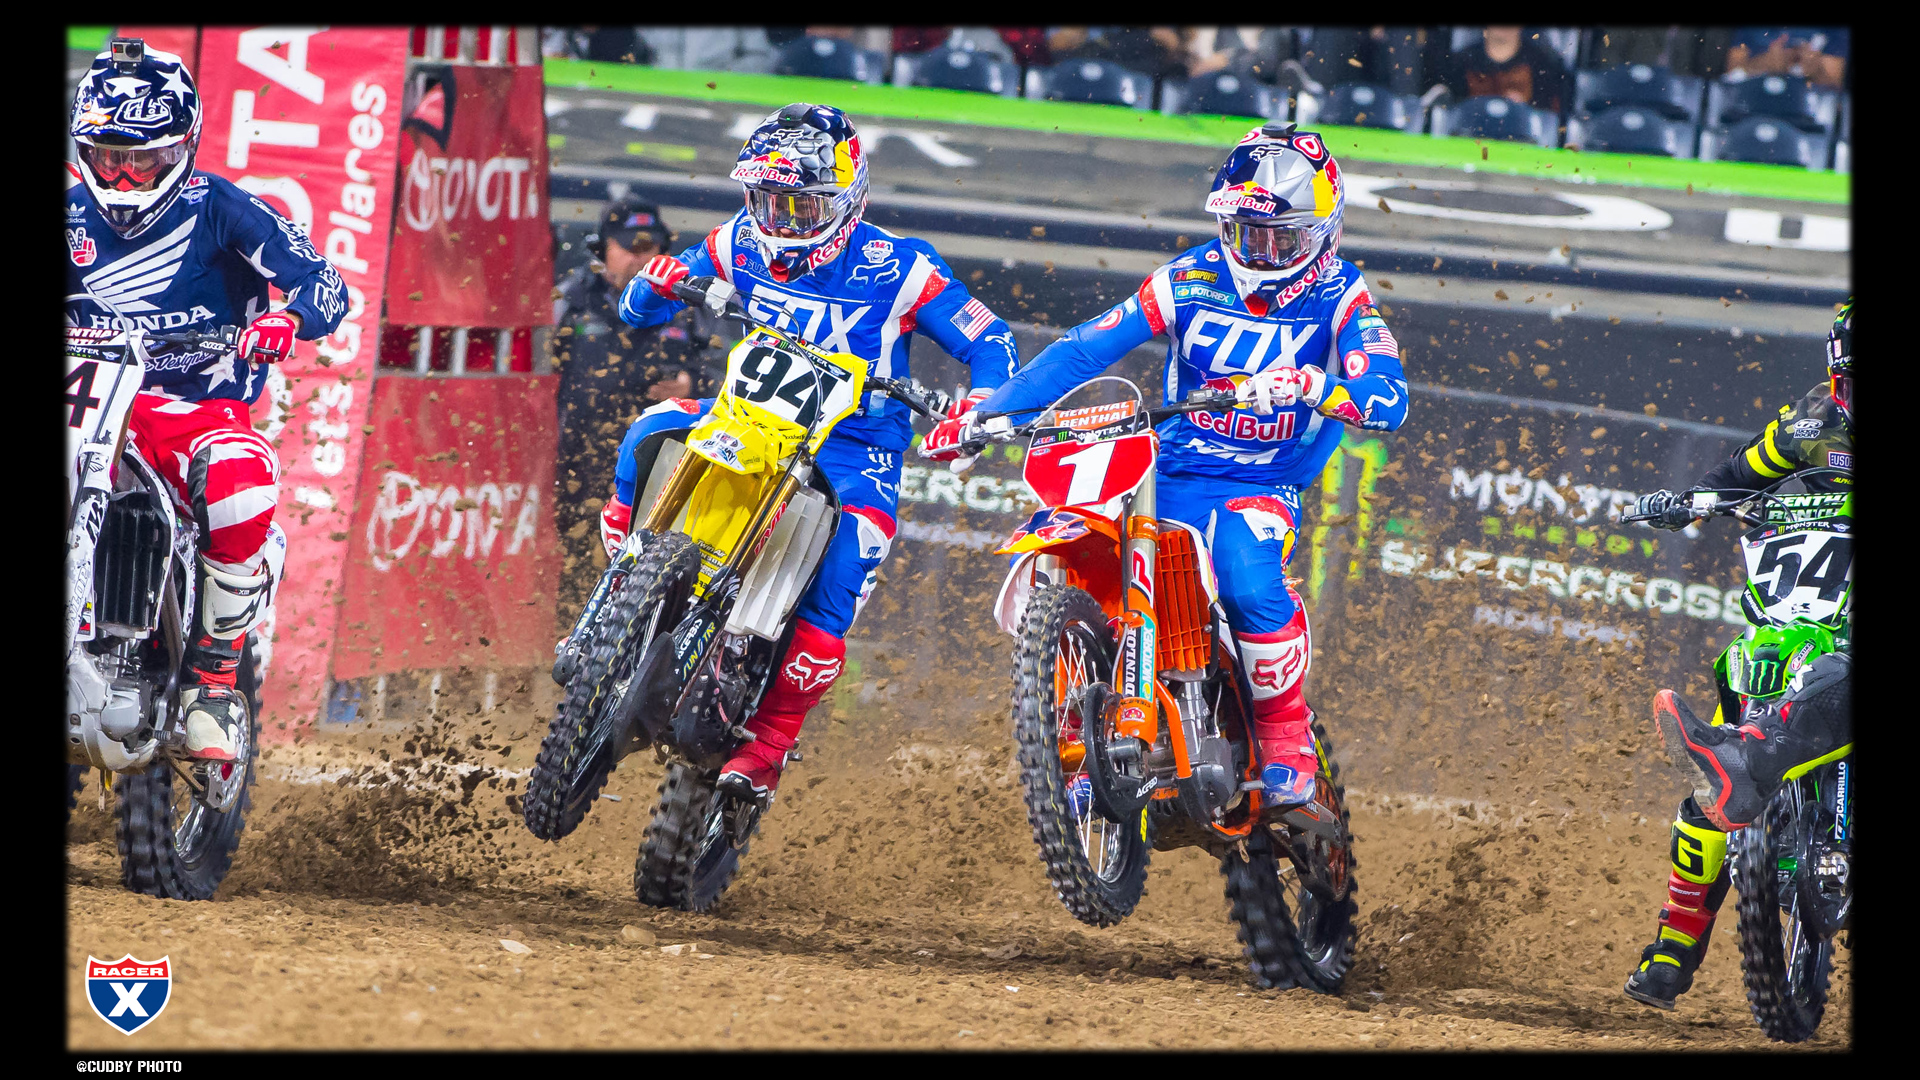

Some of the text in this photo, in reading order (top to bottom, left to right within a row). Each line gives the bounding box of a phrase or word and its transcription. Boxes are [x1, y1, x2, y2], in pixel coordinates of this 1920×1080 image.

[93, 124, 145, 138] HONDA
[734, 167, 799, 185] Red Bull
[1210, 196, 1276, 214] Red Bull
[807, 227, 847, 271] Red
[747, 259, 769, 278] SUZ
[1190, 286, 1231, 303] MOTOREX
[1276, 263, 1320, 308] Red
[89, 304, 216, 331] HONDA
[65, 346, 99, 356] ONSTER
[1181, 310, 1319, 376] FOX
[734, 346, 839, 430] 94
[1060, 410, 1127, 427] RENTHAL
[1234, 411, 1296, 441] Bull
[1058, 440, 1117, 507] 1
[1833, 455, 1850, 467] USO
[1785, 521, 1831, 531] MONSTER
[1752, 533, 1855, 608] 54
[677, 618, 703, 660] ACERBIS
[1125, 626, 1137, 698] DUNLOP
[1140, 626, 1155, 686] MOTOREX
[1836, 761, 1847, 814] CARRILLO
